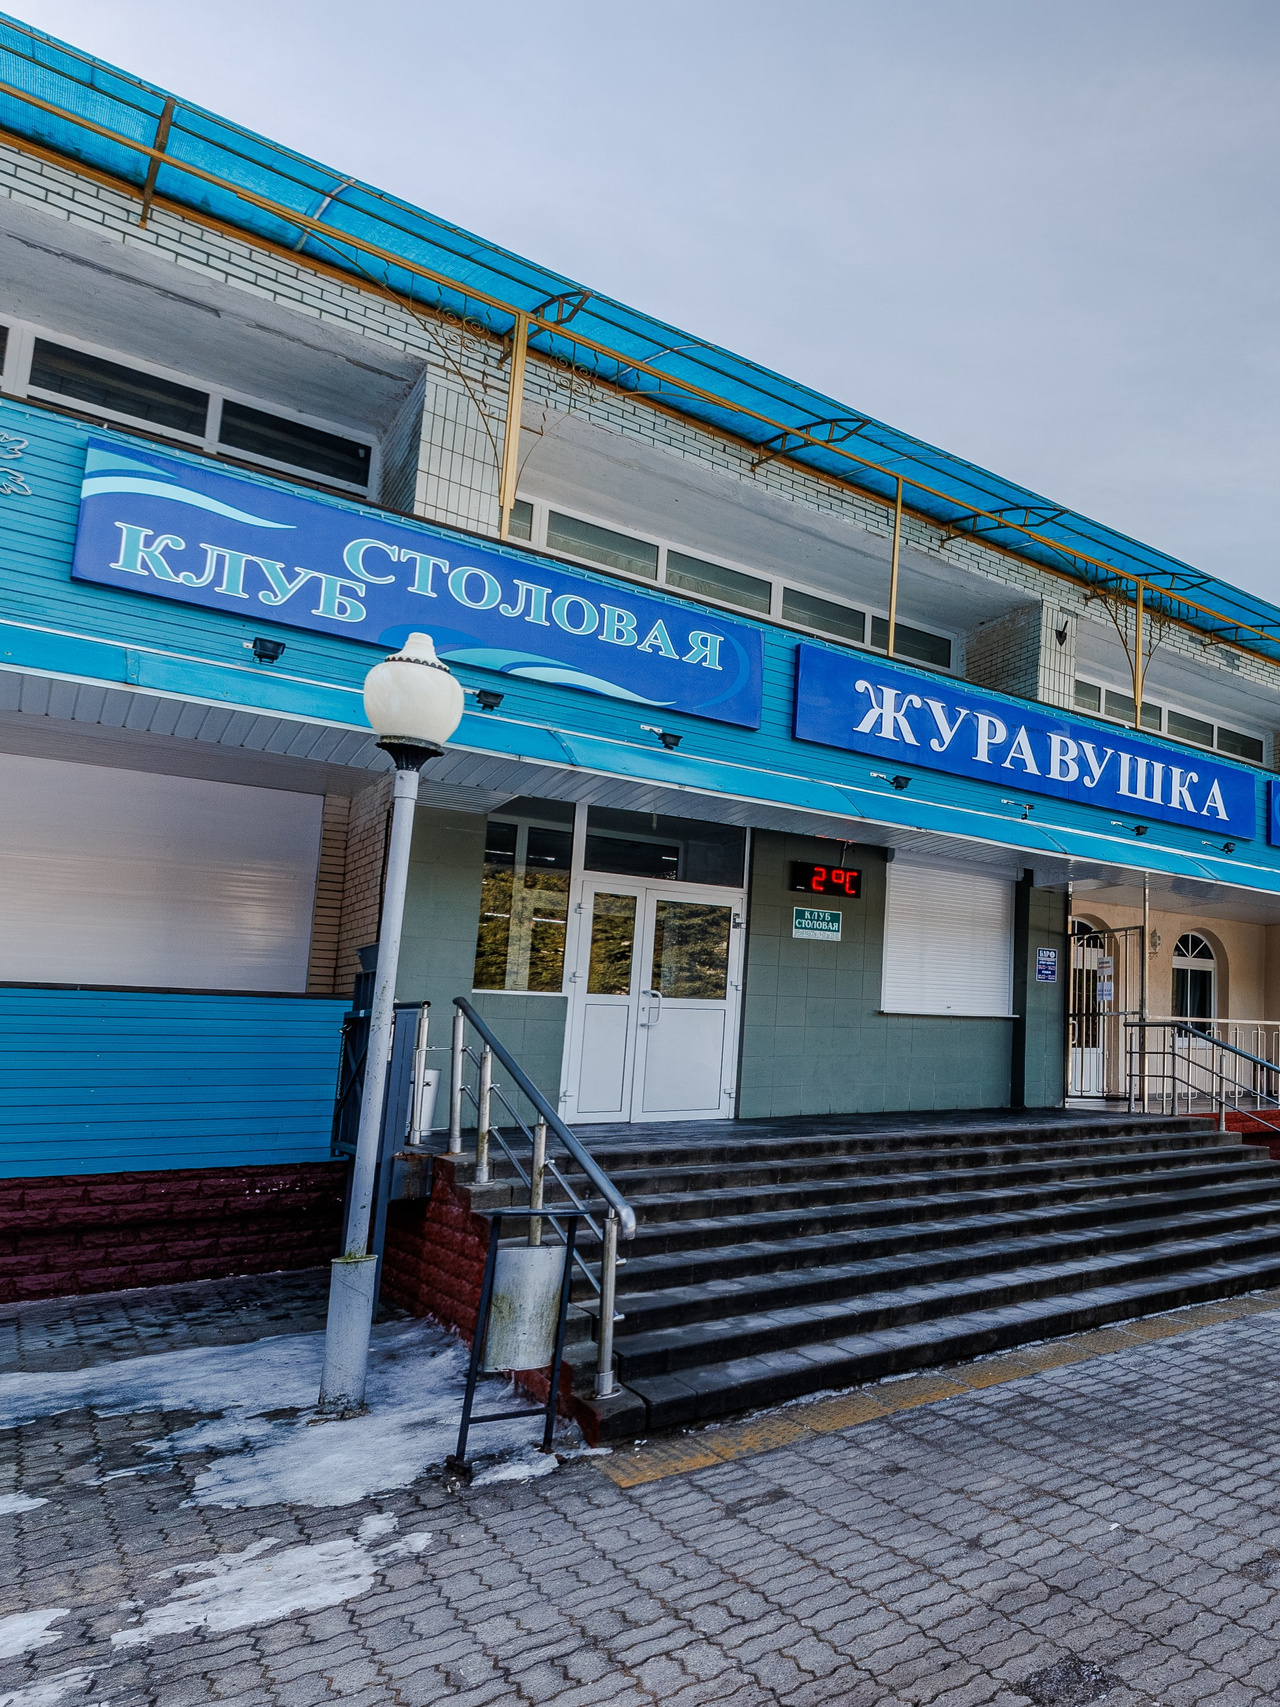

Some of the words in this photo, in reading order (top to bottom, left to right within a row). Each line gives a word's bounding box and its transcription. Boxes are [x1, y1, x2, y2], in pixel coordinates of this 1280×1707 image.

[110, 520, 367, 624] КЛУБ
[342, 537, 725, 672] СТОЛОВАЯ
[852, 679, 1230, 821] ЖУРАВУШКА
[795, 919, 839, 931] СТОЛОВАЯ
[804, 911, 831, 921] КЛУБ
